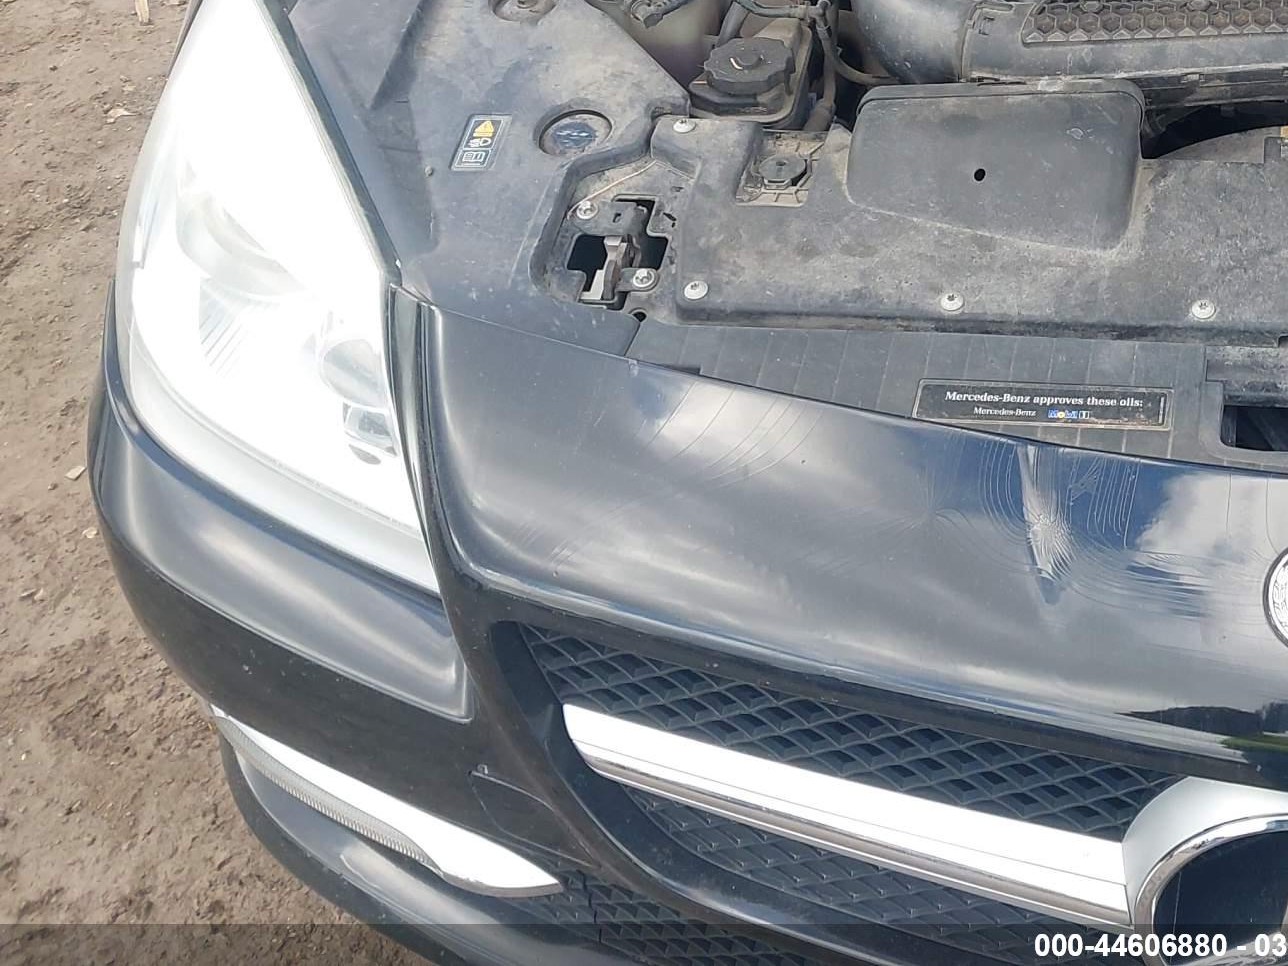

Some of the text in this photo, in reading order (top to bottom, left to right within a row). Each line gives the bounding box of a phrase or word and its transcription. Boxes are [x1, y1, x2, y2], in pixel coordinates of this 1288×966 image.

[945, 391, 1143, 407] Mercedes-Benz approves these oils:
[973, 407, 1036, 416] Mercedes-Benz
[1048, 409, 1078, 419] Mobil
